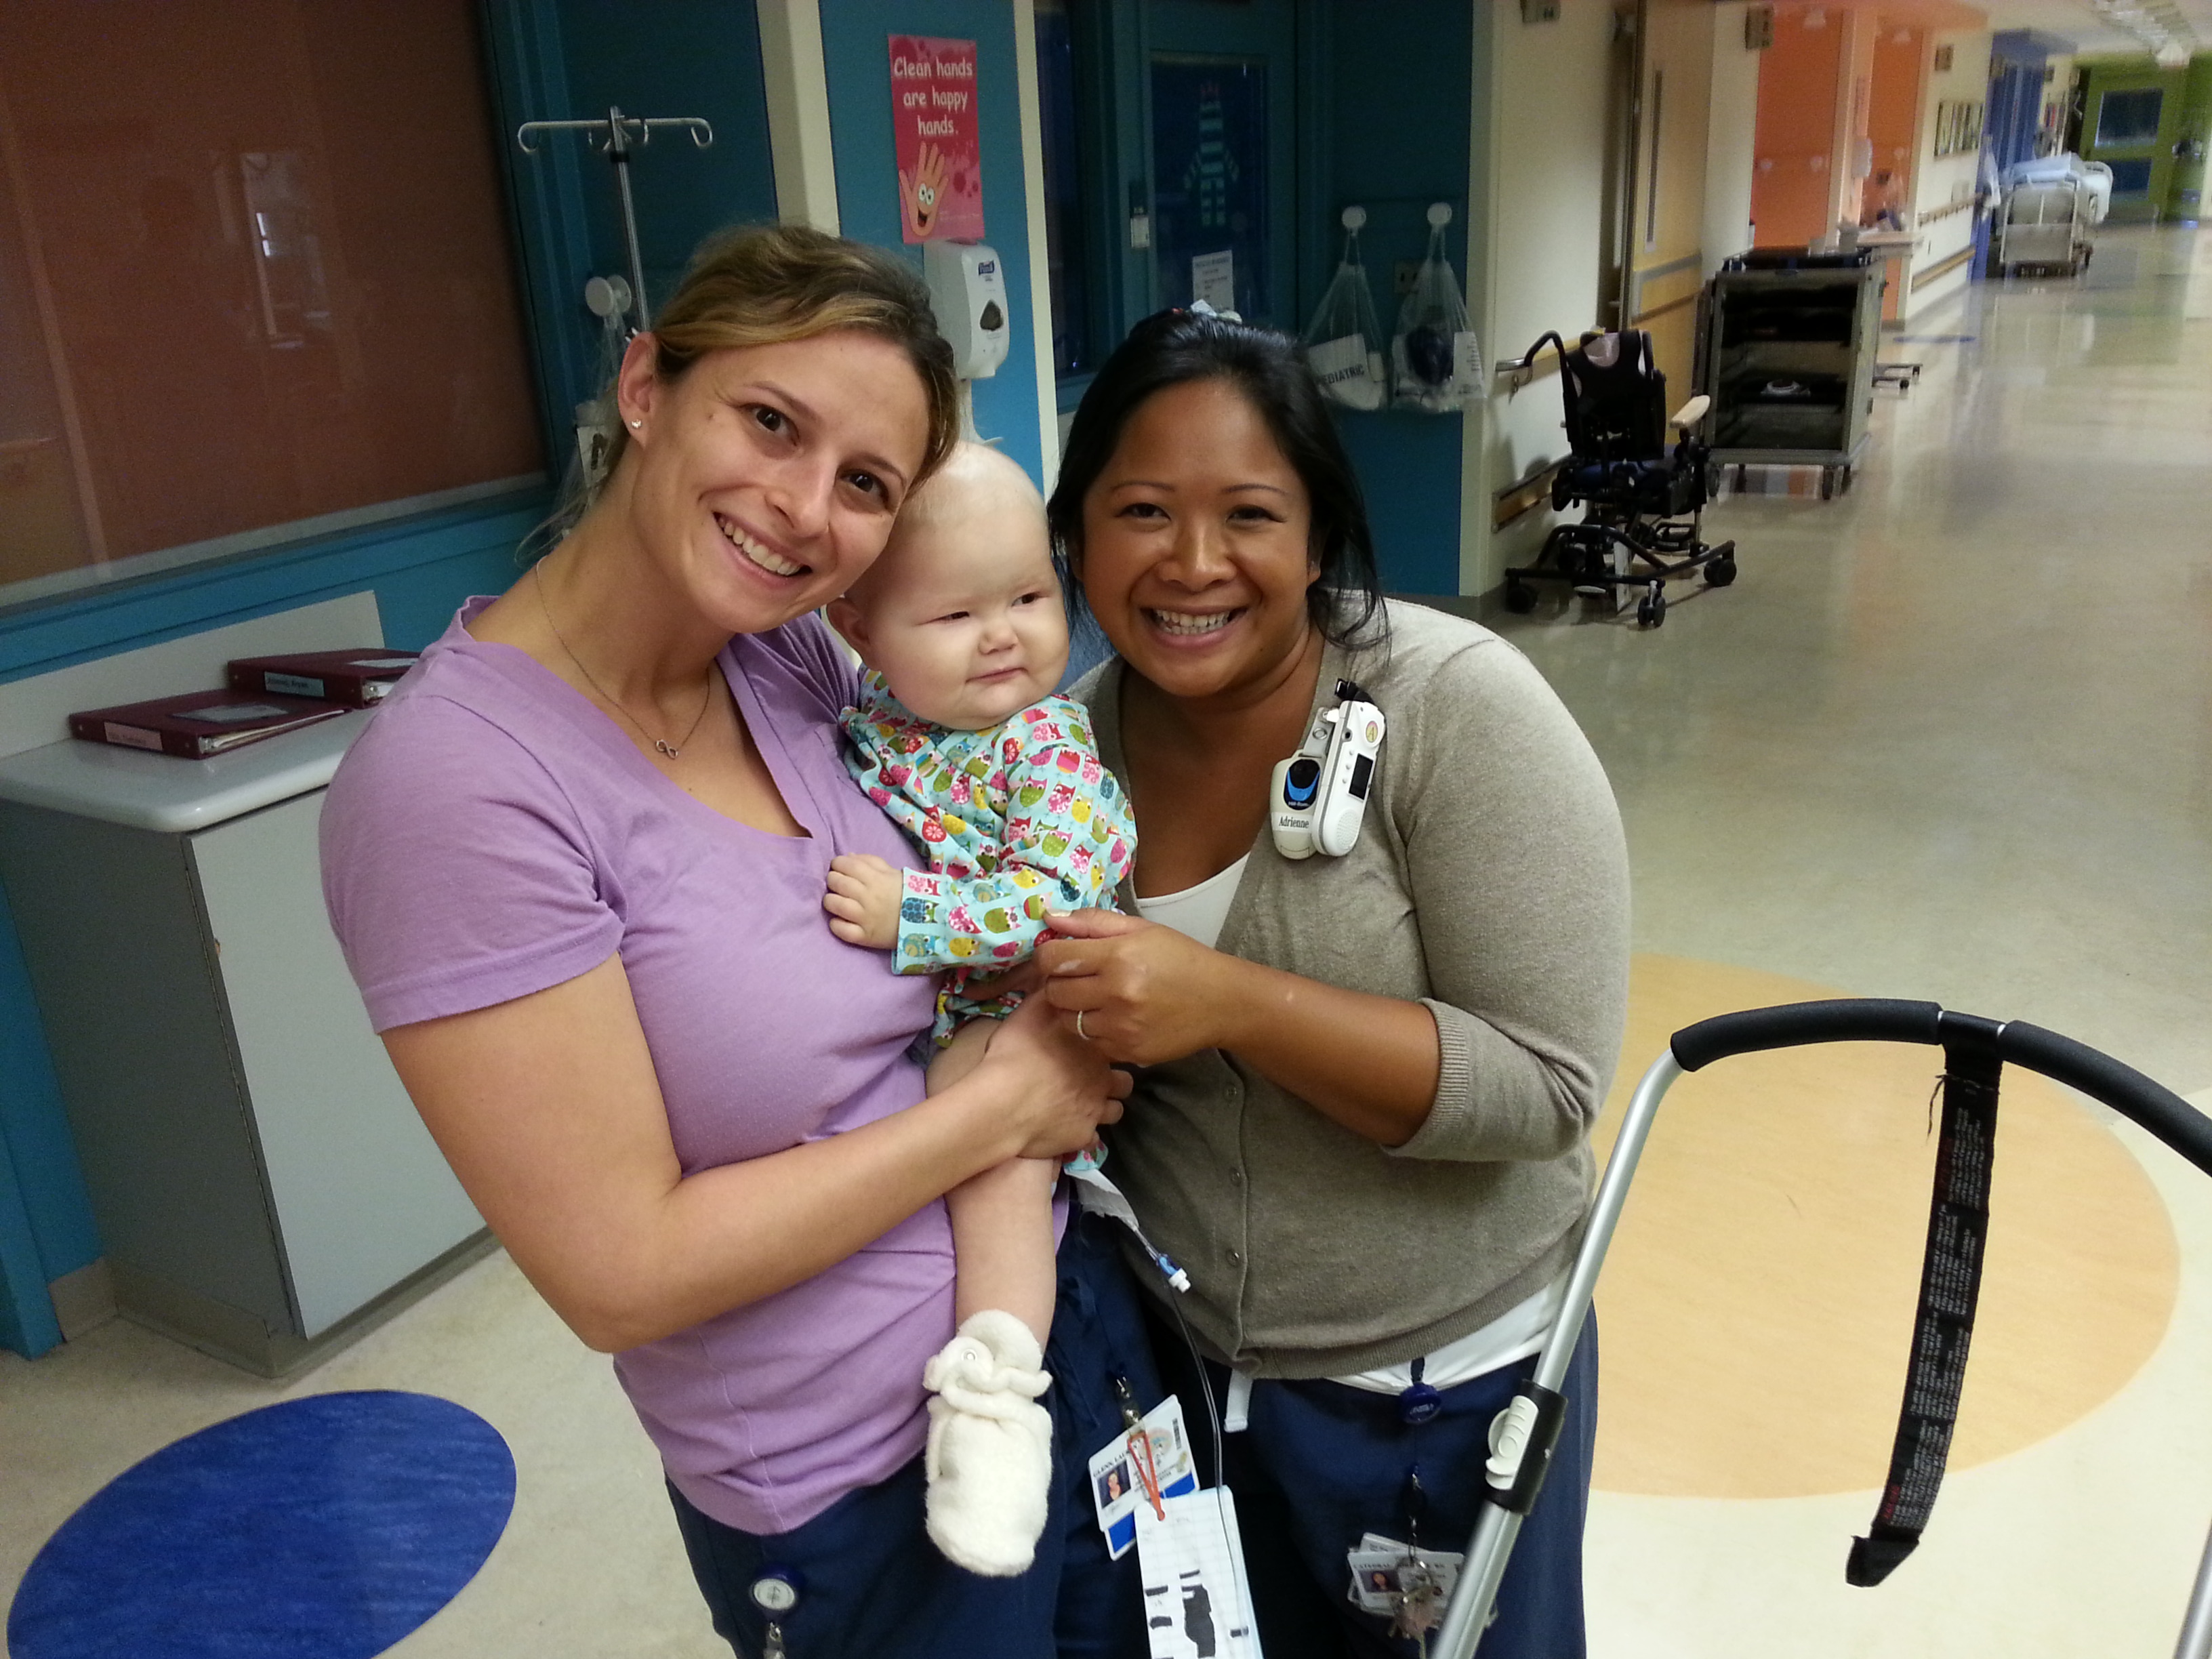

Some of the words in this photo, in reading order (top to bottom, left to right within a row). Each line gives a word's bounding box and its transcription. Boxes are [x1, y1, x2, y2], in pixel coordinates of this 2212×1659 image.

[893, 56, 932, 77] Clean
[936, 56, 972, 77] hands
[903, 91, 927, 106] are
[932, 86, 968, 112] happy
[917, 115, 959, 136] hands.
[1279, 815, 1309, 829] Adrienne
